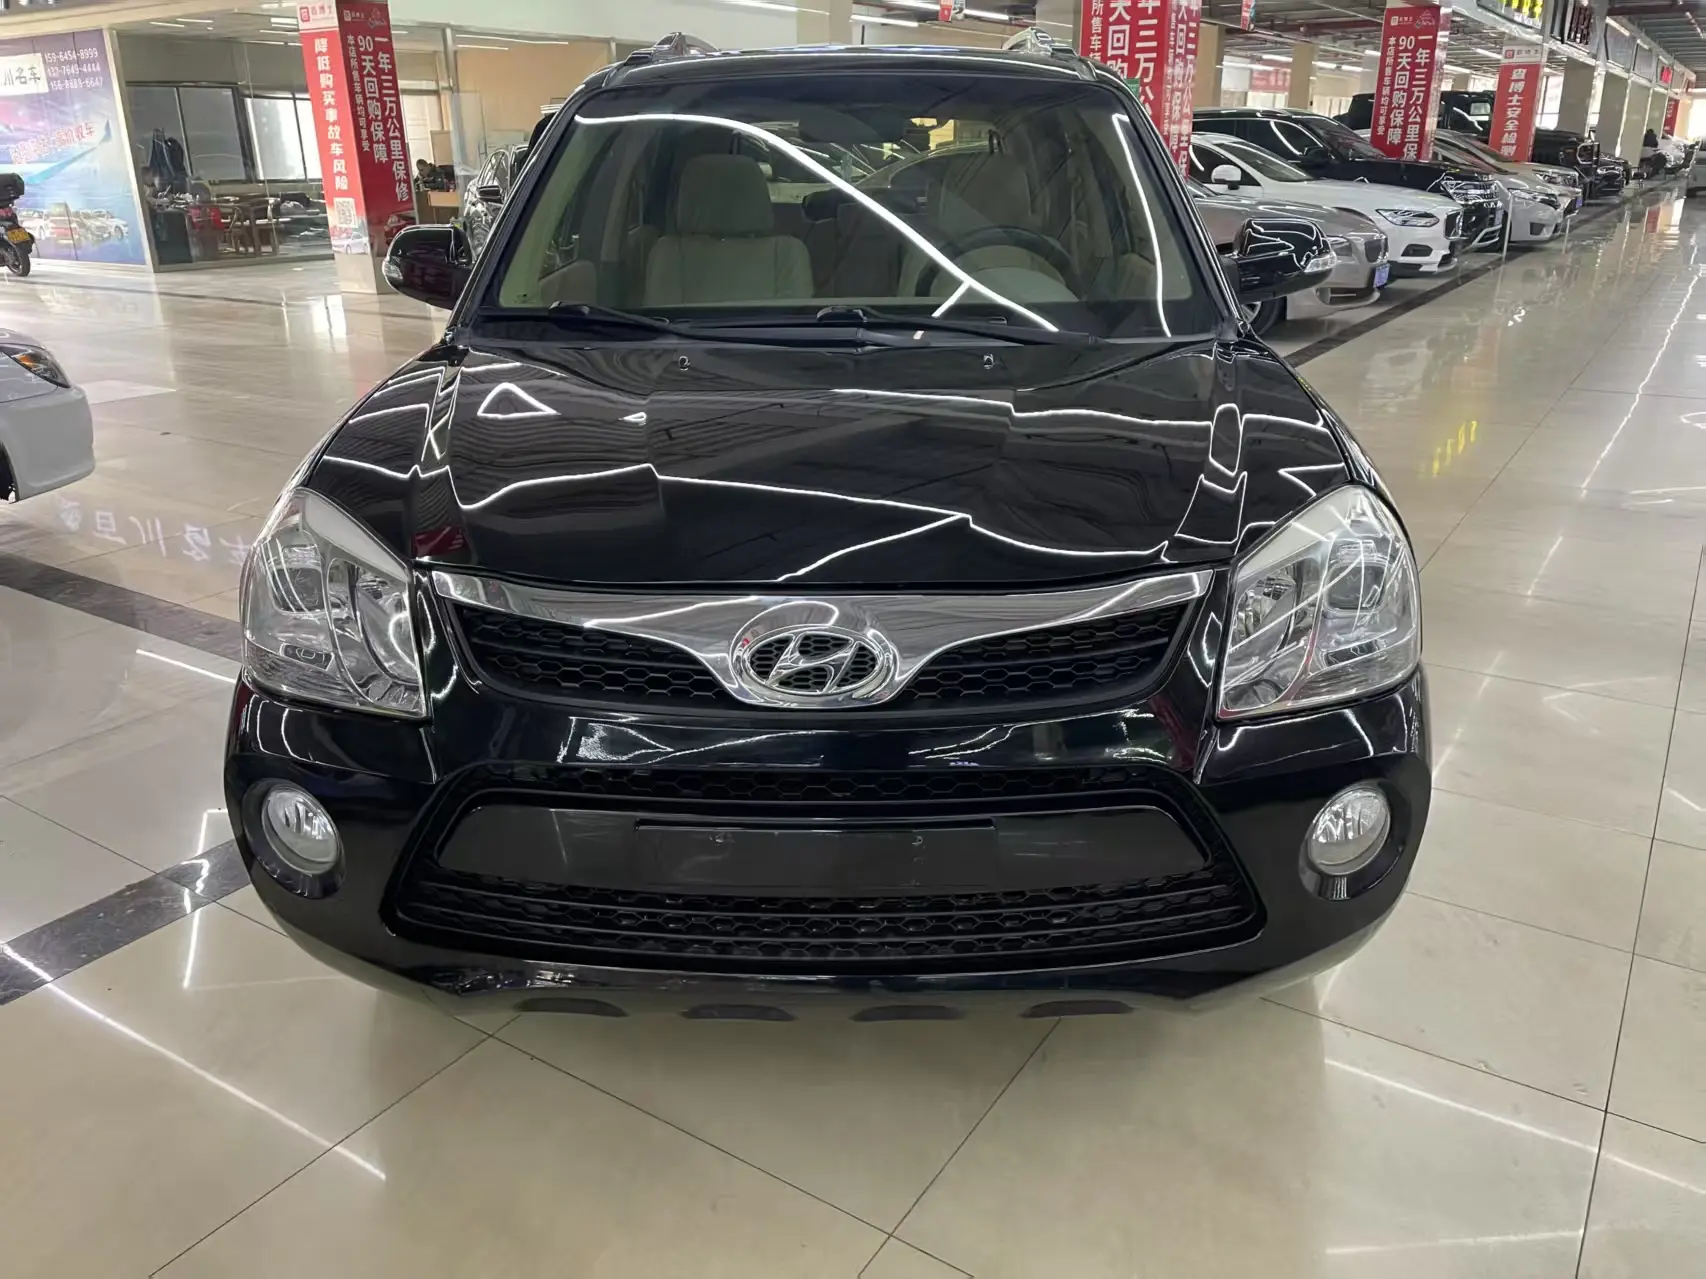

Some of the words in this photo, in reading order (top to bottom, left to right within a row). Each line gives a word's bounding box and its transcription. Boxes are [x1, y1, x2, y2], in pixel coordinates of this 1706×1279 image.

[315, 38, 348, 190] 降低购买事故车风险
[357, 36, 388, 164] 90天回购保障
[374, 37, 409, 201] 一年三万公里保修
[1376, 36, 1397, 135] 本店所售车辆均可享受
[1387, 36, 1415, 145] 90天回购保障
